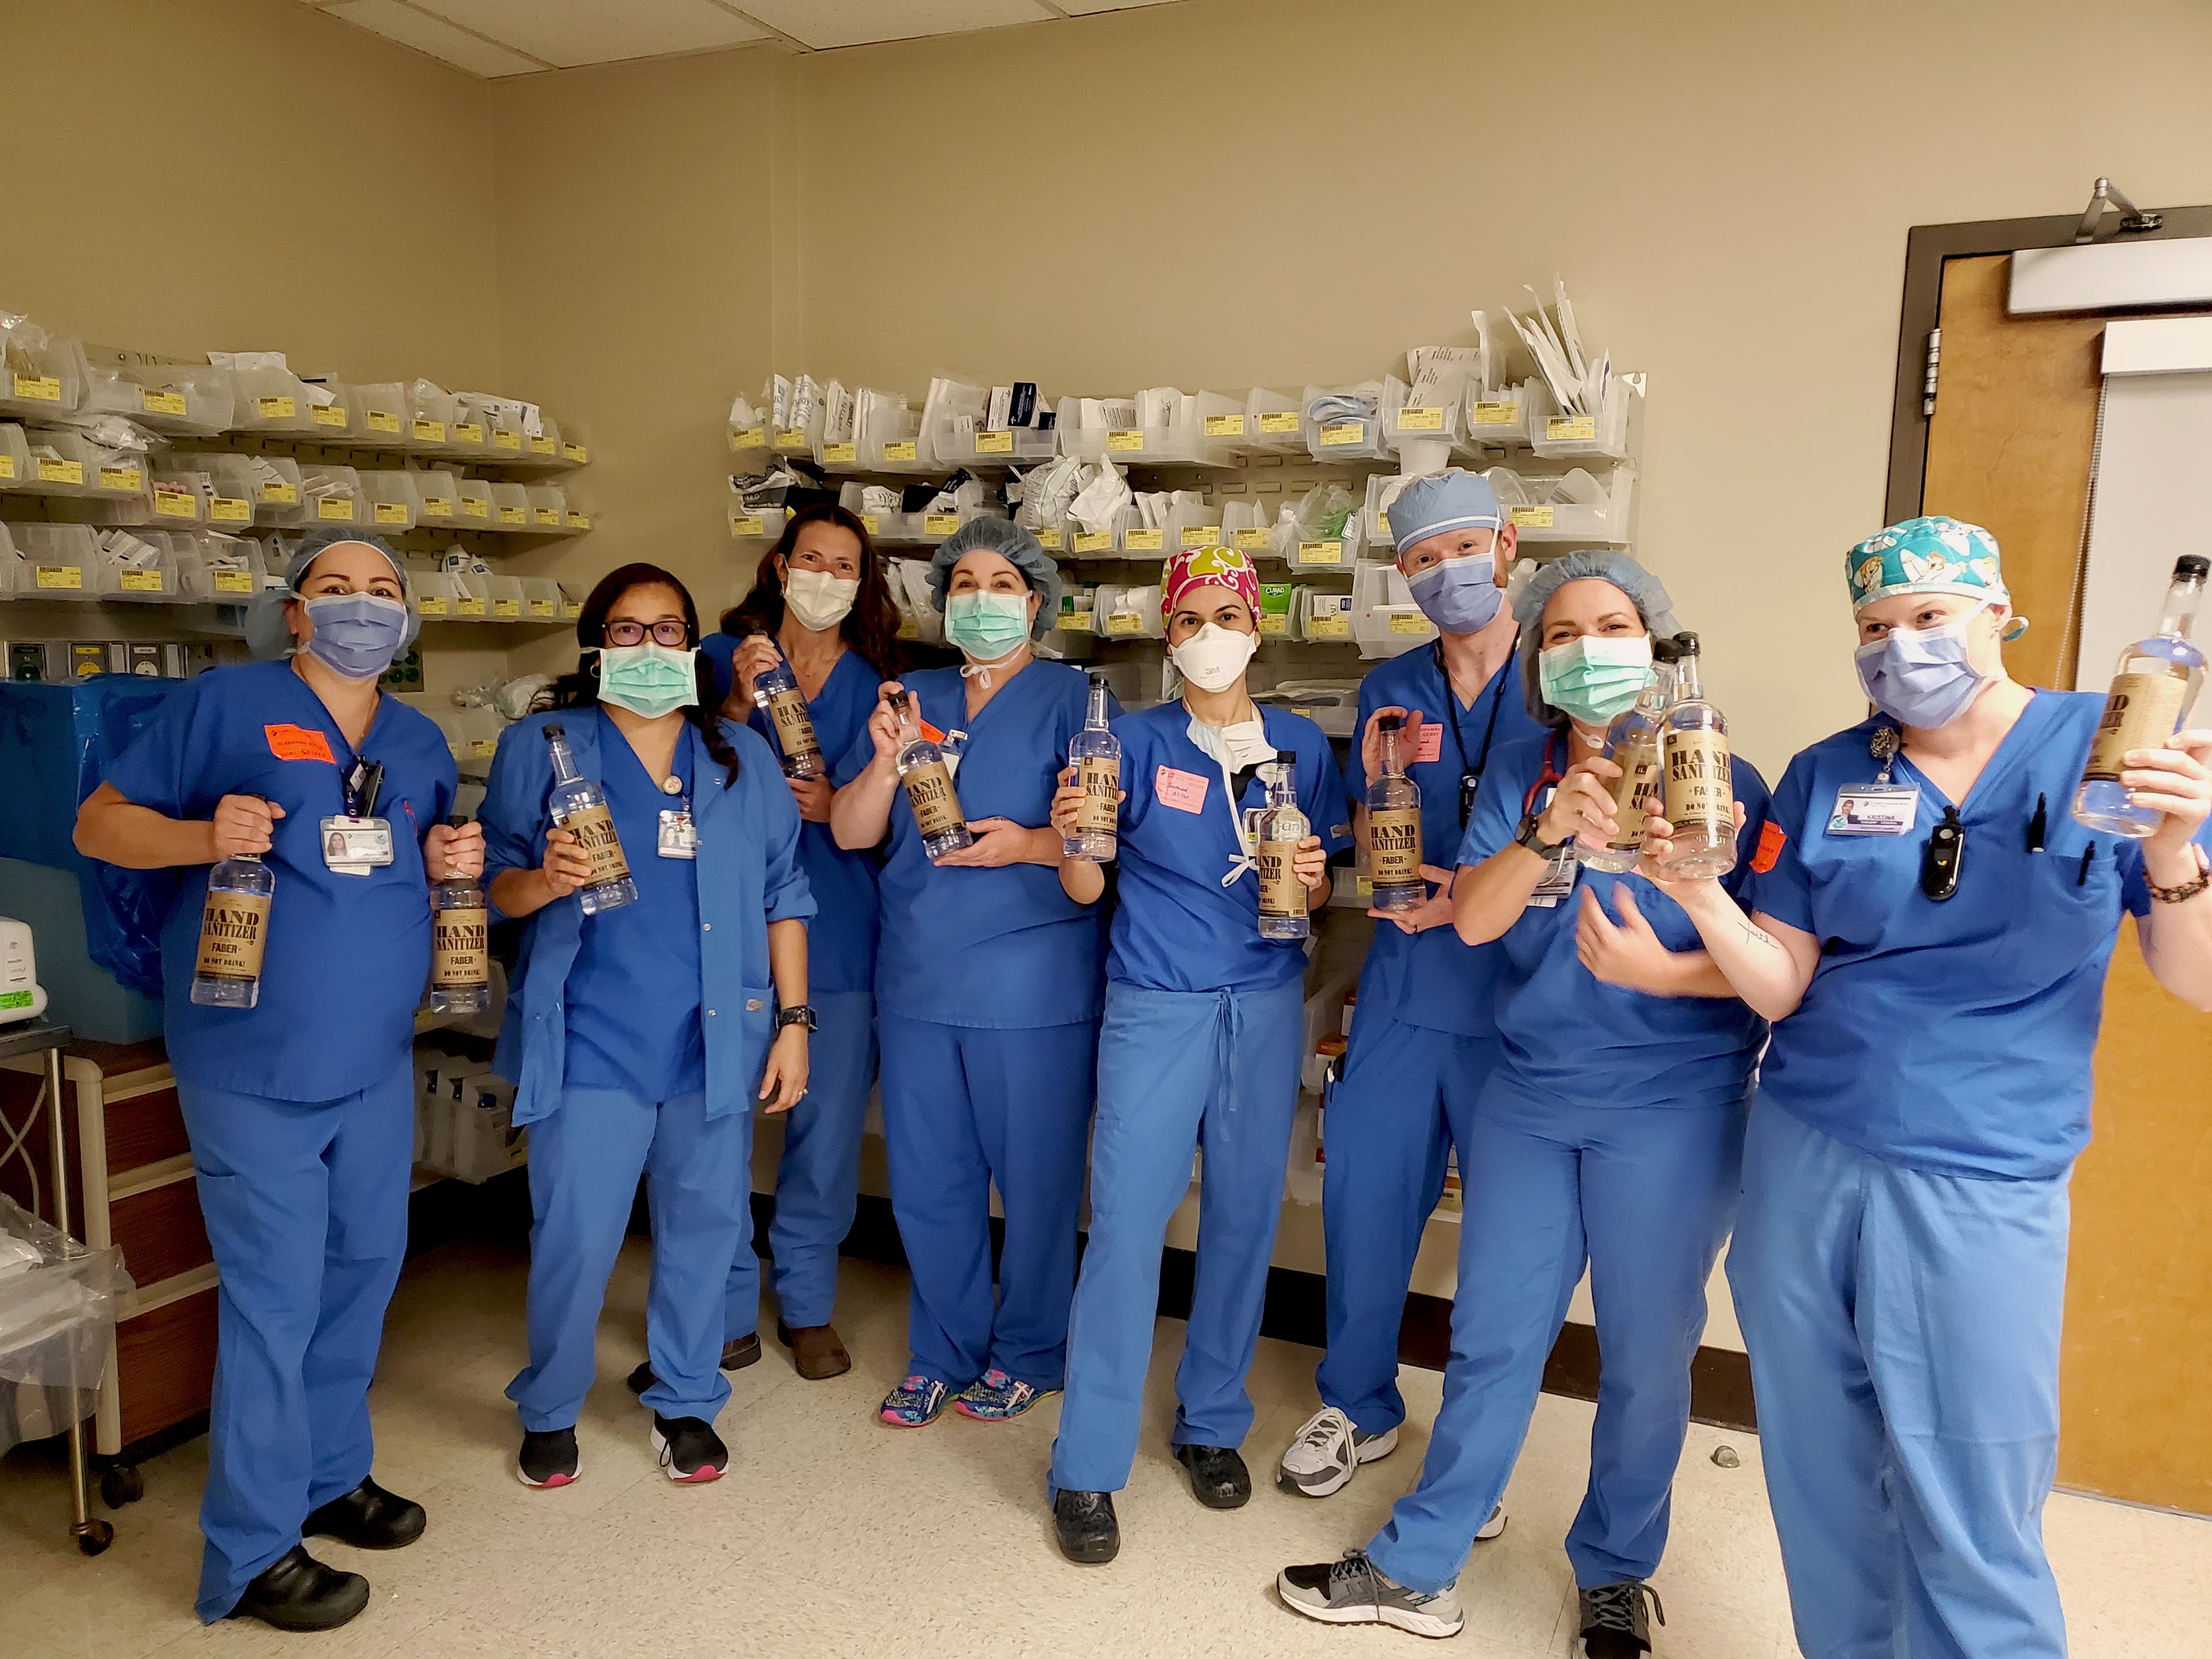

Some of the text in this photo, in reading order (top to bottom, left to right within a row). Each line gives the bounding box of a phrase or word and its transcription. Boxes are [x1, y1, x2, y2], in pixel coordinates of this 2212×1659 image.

[1205, 666, 1220, 675] 3M
[777, 702, 806, 718] HAN
[1087, 772, 1118, 788] HAN
[1634, 782, 1658, 797] HA
[1694, 786, 1722, 798] FAER
[921, 806, 938, 818] FABER
[1370, 824, 1415, 839] HAND
[1259, 855, 1282, 868] ND
[1382, 855, 1404, 865] FABER
[205, 908, 259, 926] HAND
[203, 922, 257, 940] ANITIZER
[437, 925, 484, 938] HAND
[211, 942, 238, 954] FABER
[437, 937, 484, 951] SANITIZER
[224, 959, 245, 967] DRINK!
[450, 956, 474, 965] FABER
